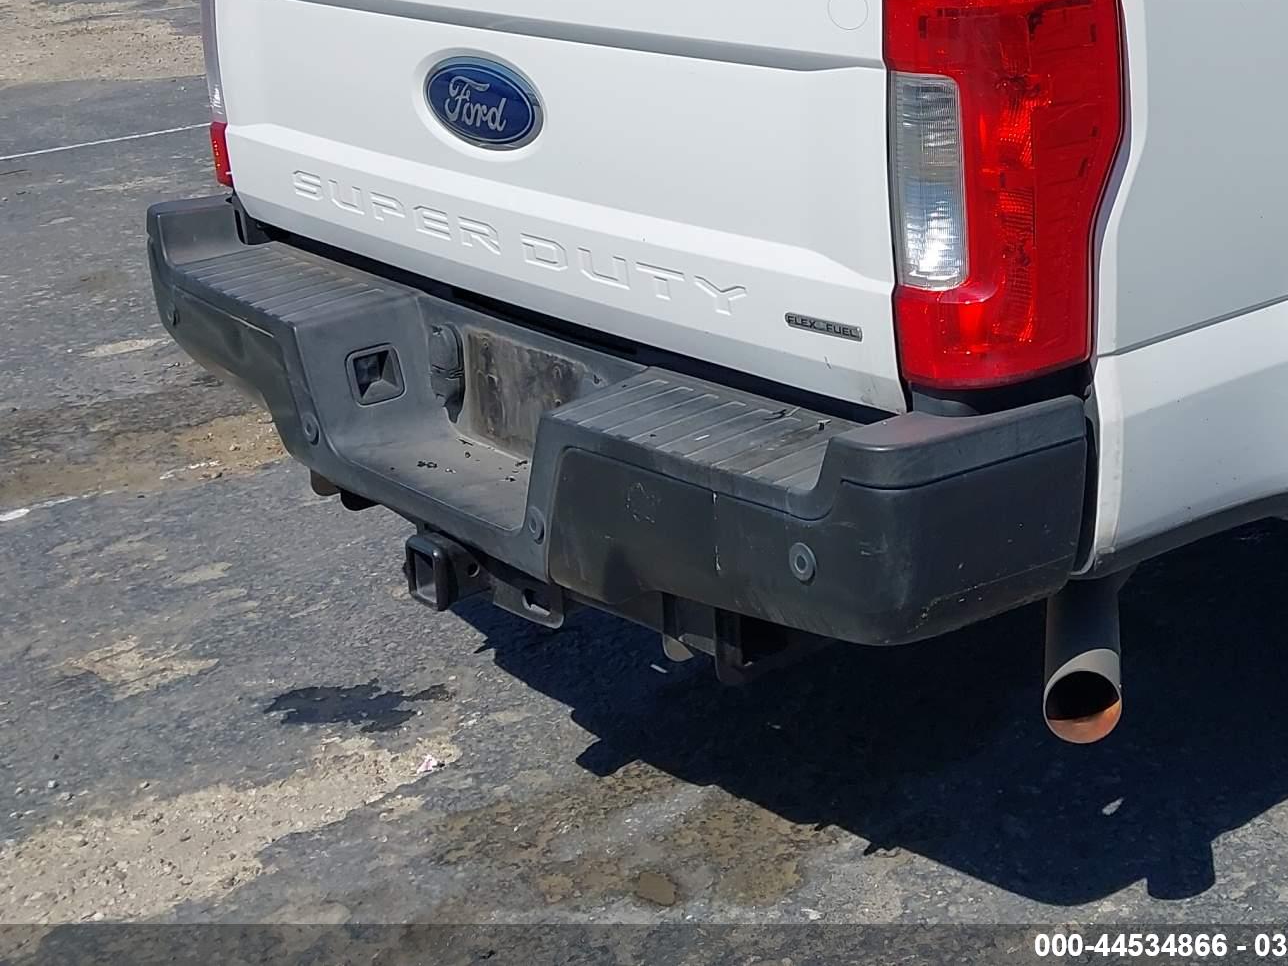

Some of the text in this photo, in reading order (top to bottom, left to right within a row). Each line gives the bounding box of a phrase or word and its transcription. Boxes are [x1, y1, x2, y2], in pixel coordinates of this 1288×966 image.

[445, 75, 507, 132] Ford
[293, 170, 748, 316] SUPER DUTY
[787, 315, 861, 339] FLEX FUEL
